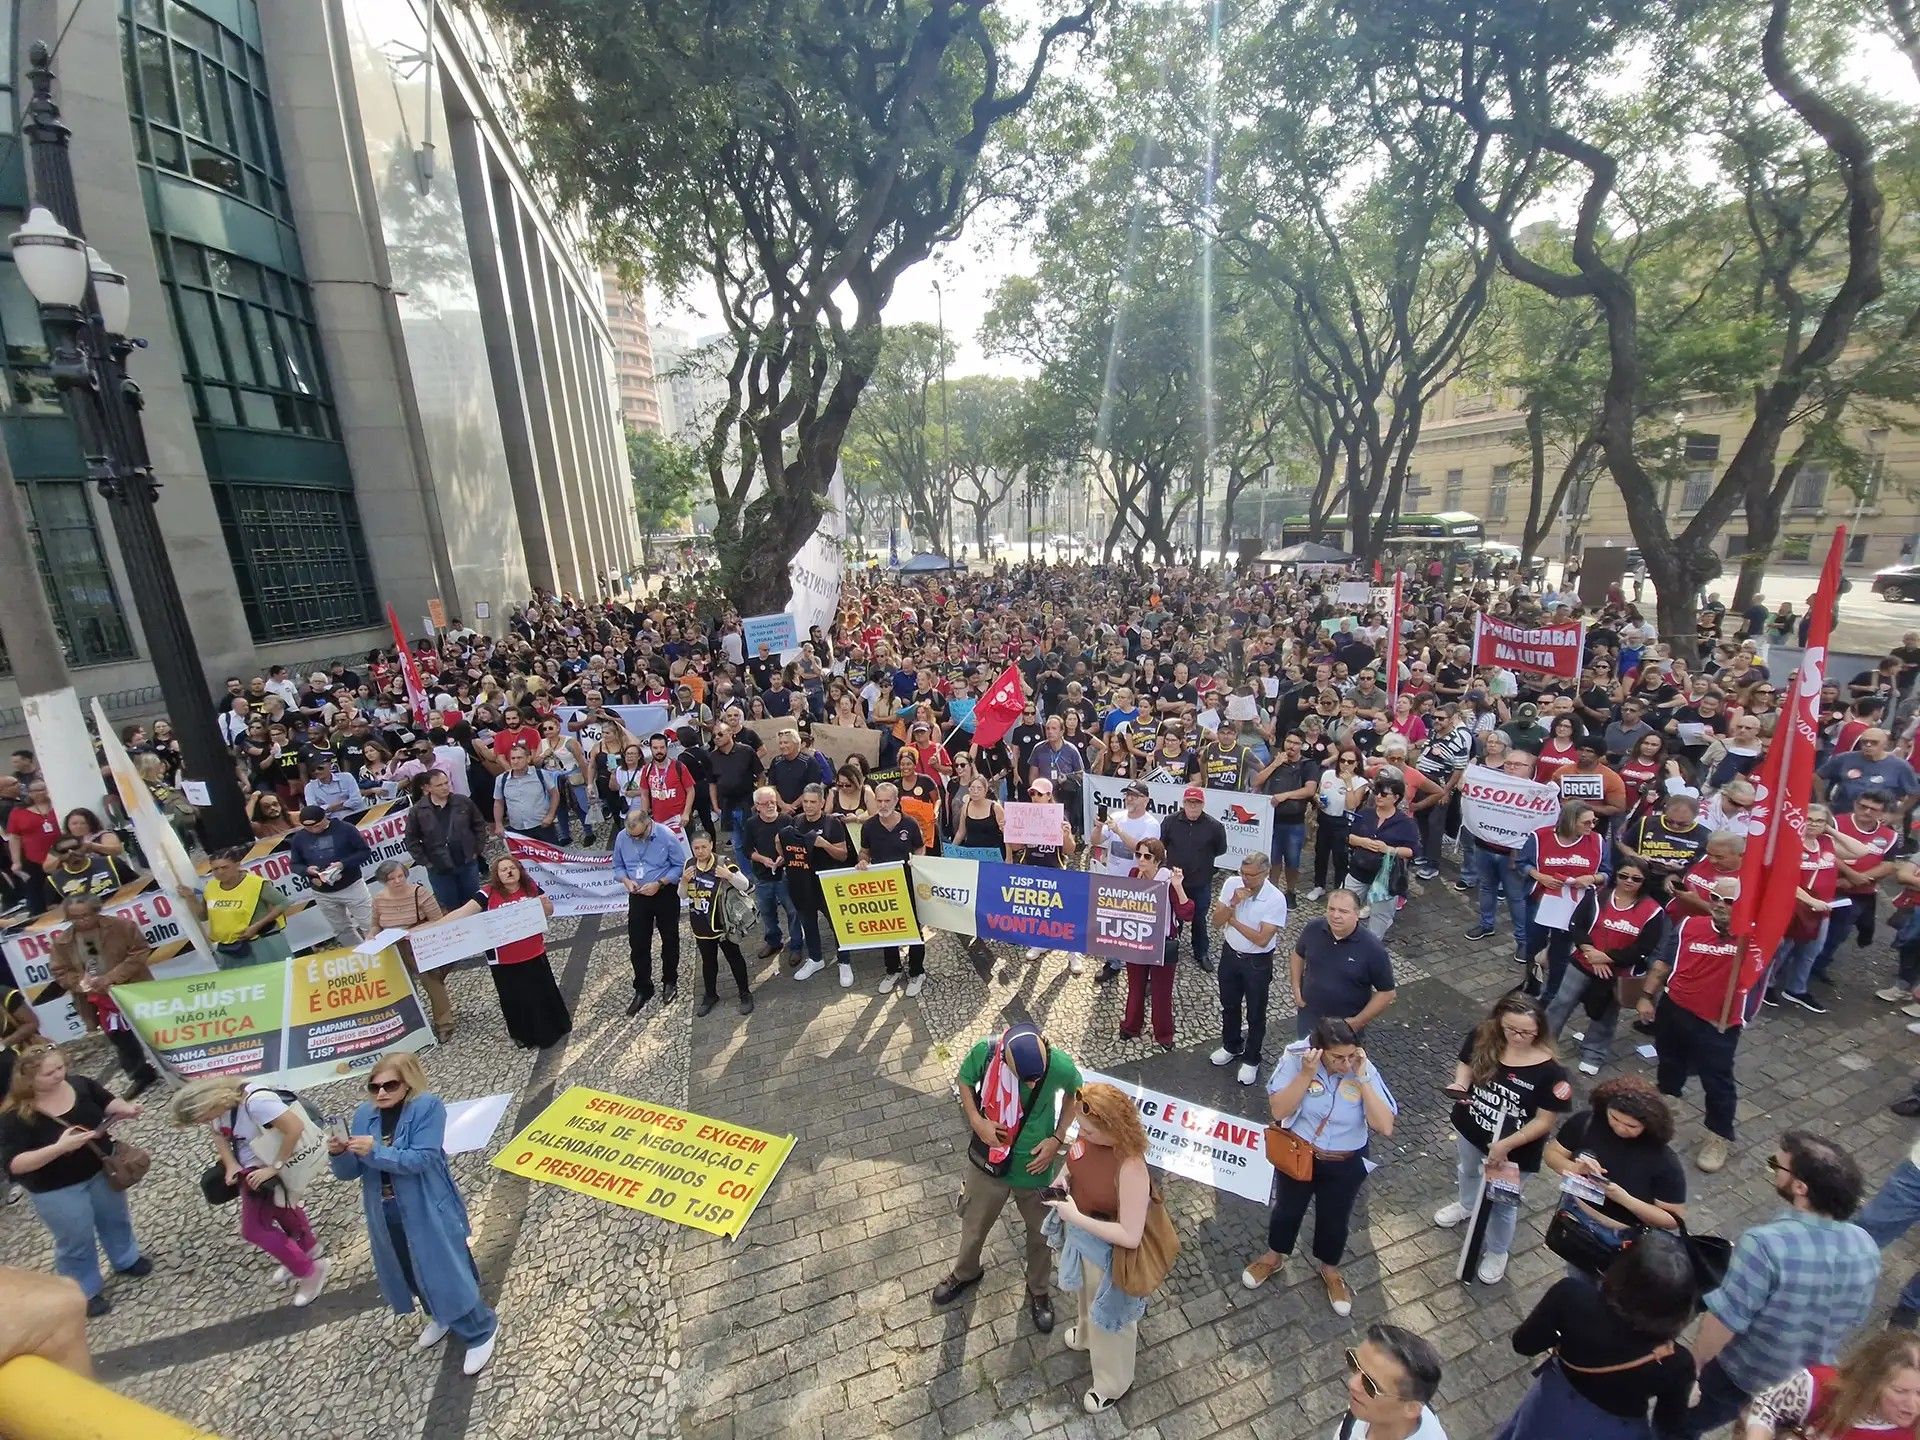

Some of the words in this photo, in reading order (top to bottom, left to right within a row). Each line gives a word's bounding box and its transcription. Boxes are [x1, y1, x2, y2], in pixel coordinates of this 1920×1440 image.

[1482, 620, 1577, 647] PIRACICABA
[1495, 643, 1516, 661] NA
[1517, 648, 1555, 668] LUTA
[1563, 781, 1600, 796] GREVE
[1478, 821, 1517, 836] Sempre
[834, 883, 846, 898] É
[848, 879, 898, 896] GREVE
[1009, 876, 1034, 887] TJSP
[1036, 878, 1057, 890] TEM
[931, 885, 970, 905] ASSETJ
[1001, 886, 1063, 909] VERBA
[1098, 886, 1157, 903] CAMPANHA
[152, 895, 172, 918] O
[840, 899, 898, 916] PORQUE
[1012, 905, 1042, 917] FALTA
[1044, 906, 1051, 919] É
[1098, 896, 1156, 914] SALARIAL
[845, 920, 855, 934] É
[858, 917, 907, 933] GRAVE
[986, 912, 1076, 940] VONTADE
[1096, 917, 1153, 943] TJSP
[307, 959, 320, 984] É
[323, 951, 382, 978] GREVE
[187, 981, 216, 993] SEM
[327, 972, 368, 990] PORQUE
[133, 984, 266, 1019] REAJUSTE
[309, 989, 322, 1013] É
[327, 979, 391, 1009] GRAVE
[175, 1010, 205, 1025] NÃO
[208, 1006, 228, 1019] HÁ
[308, 1018, 357, 1037] CAMPANHA
[357, 1008, 399, 1026] SALARIAL
[207, 1039, 264, 1056] SALARIAL
[309, 1031, 356, 1047] Judiciários
[358, 1030, 369, 1038] em
[207, 1059, 224, 1067] em
[227, 1051, 262, 1064] Greve!
[308, 1047, 335, 1059] TJSP
[1162, 1102, 1178, 1124] É
[585, 1097, 688, 1132] SERVIDORES
[696, 1125, 768, 1155] EXIGEM
[565, 1115, 607, 1135] MESA
[611, 1125, 633, 1142] DE
[638, 1134, 743, 1172] NEGOCIAÇÃO
[746, 1162, 760, 1176] E
[1170, 1134, 1189, 1148] as
[1193, 1141, 1248, 1168] pautas
[527, 1130, 620, 1164] CALENDÁRIO
[619, 1153, 708, 1188] DEFINIDOS
[1219, 1167, 1237, 1177] por
[515, 1151, 534, 1167] O
[534, 1156, 644, 1199] PRESIDENTE
[646, 1187, 677, 1208] DO
[683, 1198, 735, 1225] TJSP
